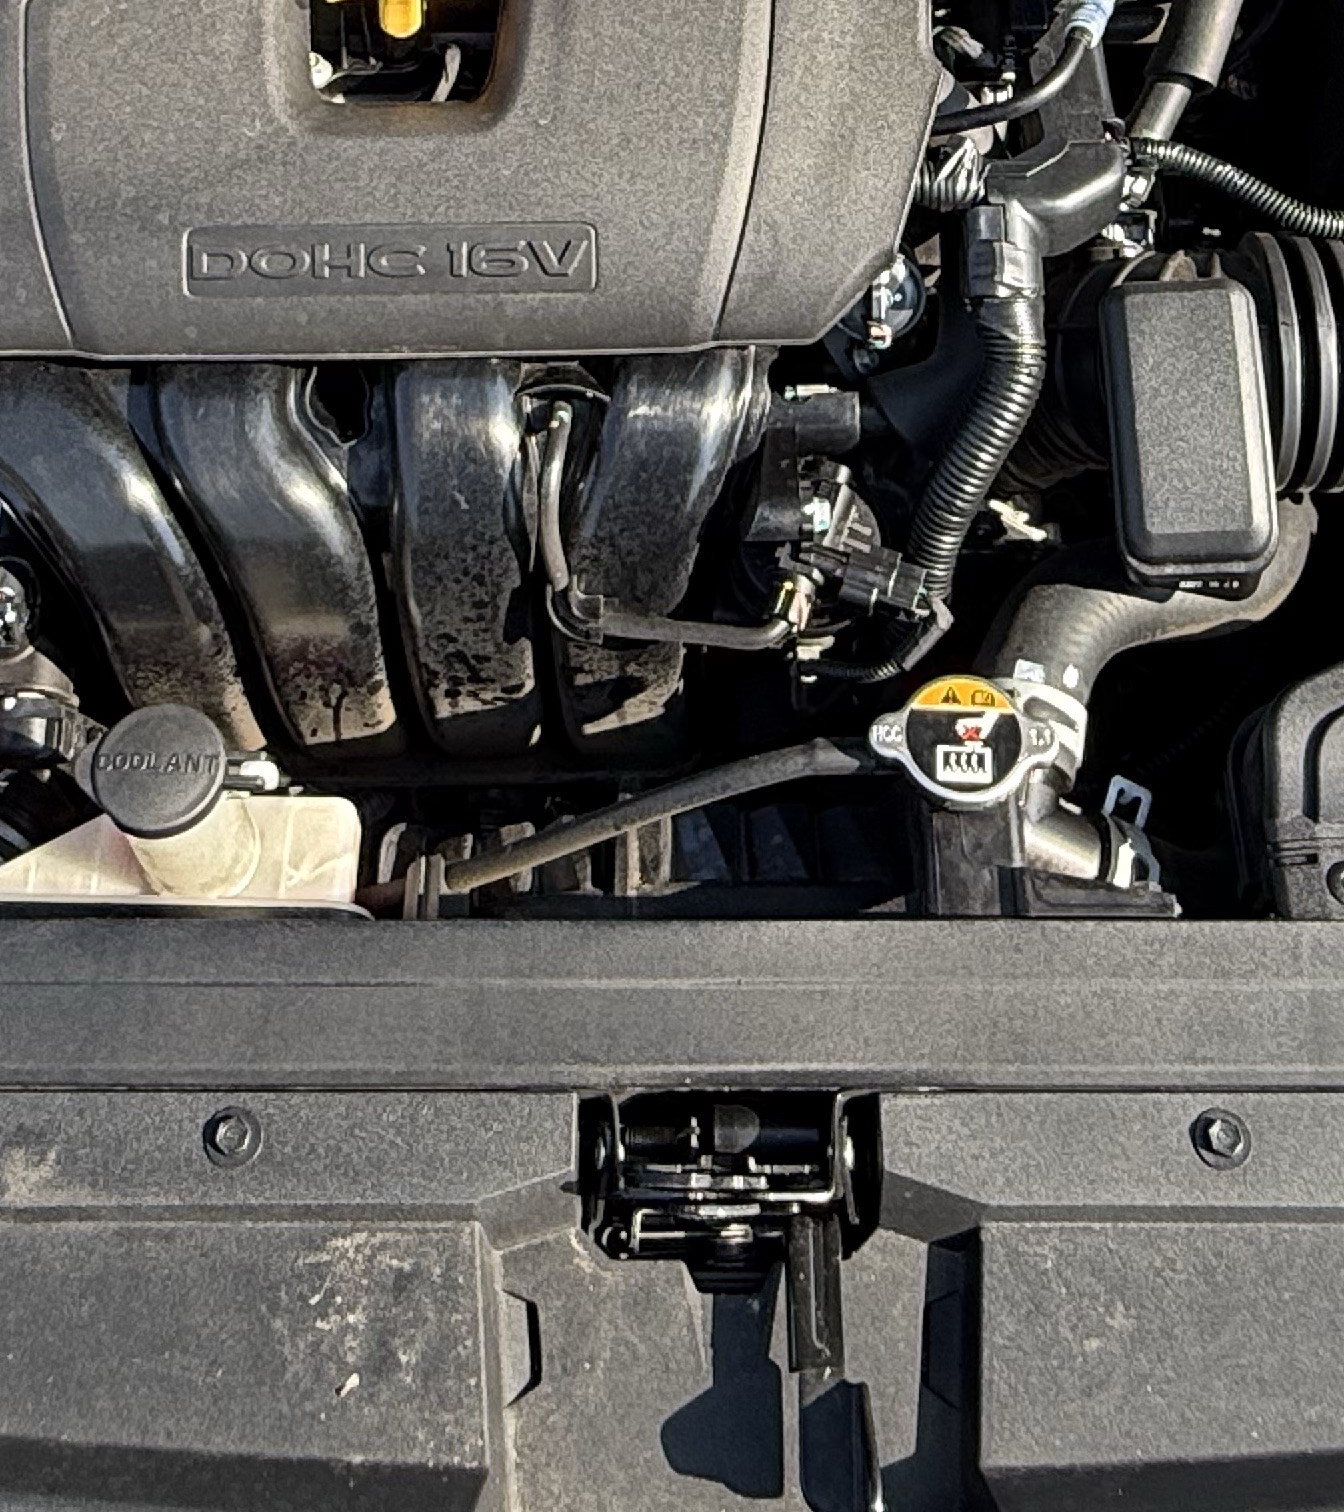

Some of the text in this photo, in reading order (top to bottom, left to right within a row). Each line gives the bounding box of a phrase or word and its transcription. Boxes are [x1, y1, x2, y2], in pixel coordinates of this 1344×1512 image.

[188, 238, 589, 282] DOHC 16V
[1029, 727, 1052, 747] 1.1
[96, 750, 220, 775] COOLANT
